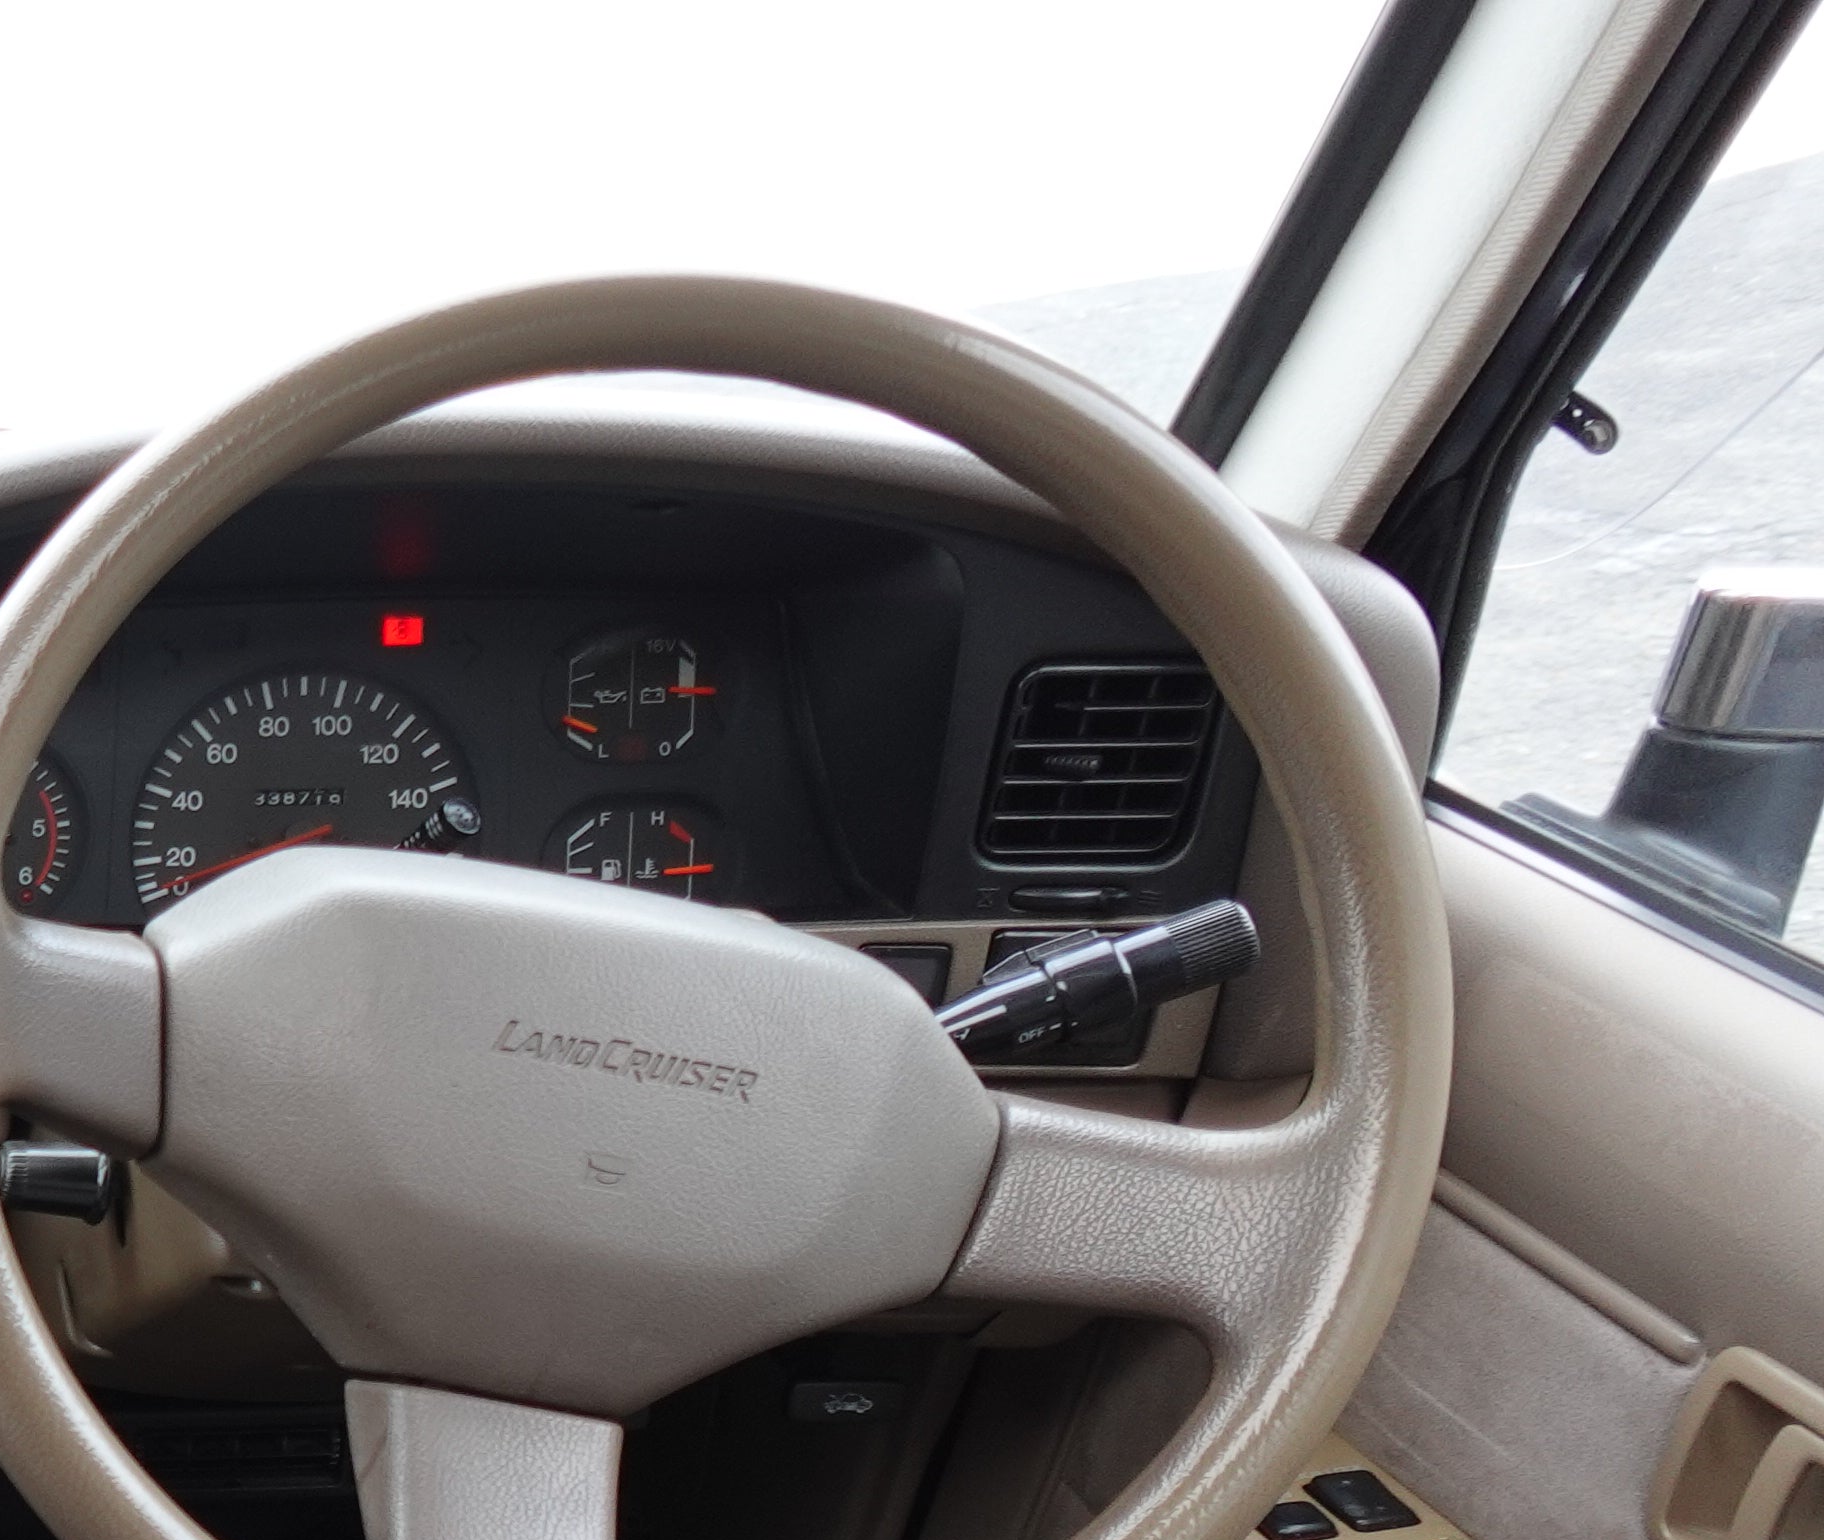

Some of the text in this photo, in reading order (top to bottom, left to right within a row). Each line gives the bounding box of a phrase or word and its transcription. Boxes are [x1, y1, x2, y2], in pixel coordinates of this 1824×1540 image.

[258, 716, 290, 737] 80
[312, 715, 352, 736] 100
[206, 743, 238, 765] 60
[359, 743, 399, 765] 120
[171, 790, 203, 812] 40
[389, 788, 428, 809] 140
[32, 819, 46, 838] 5
[600, 812, 612, 826] F
[651, 811, 665, 826] H
[165, 846, 196, 867] 20
[19, 867, 33, 885] 6
[1018, 1025, 1046, 1043] OFF
